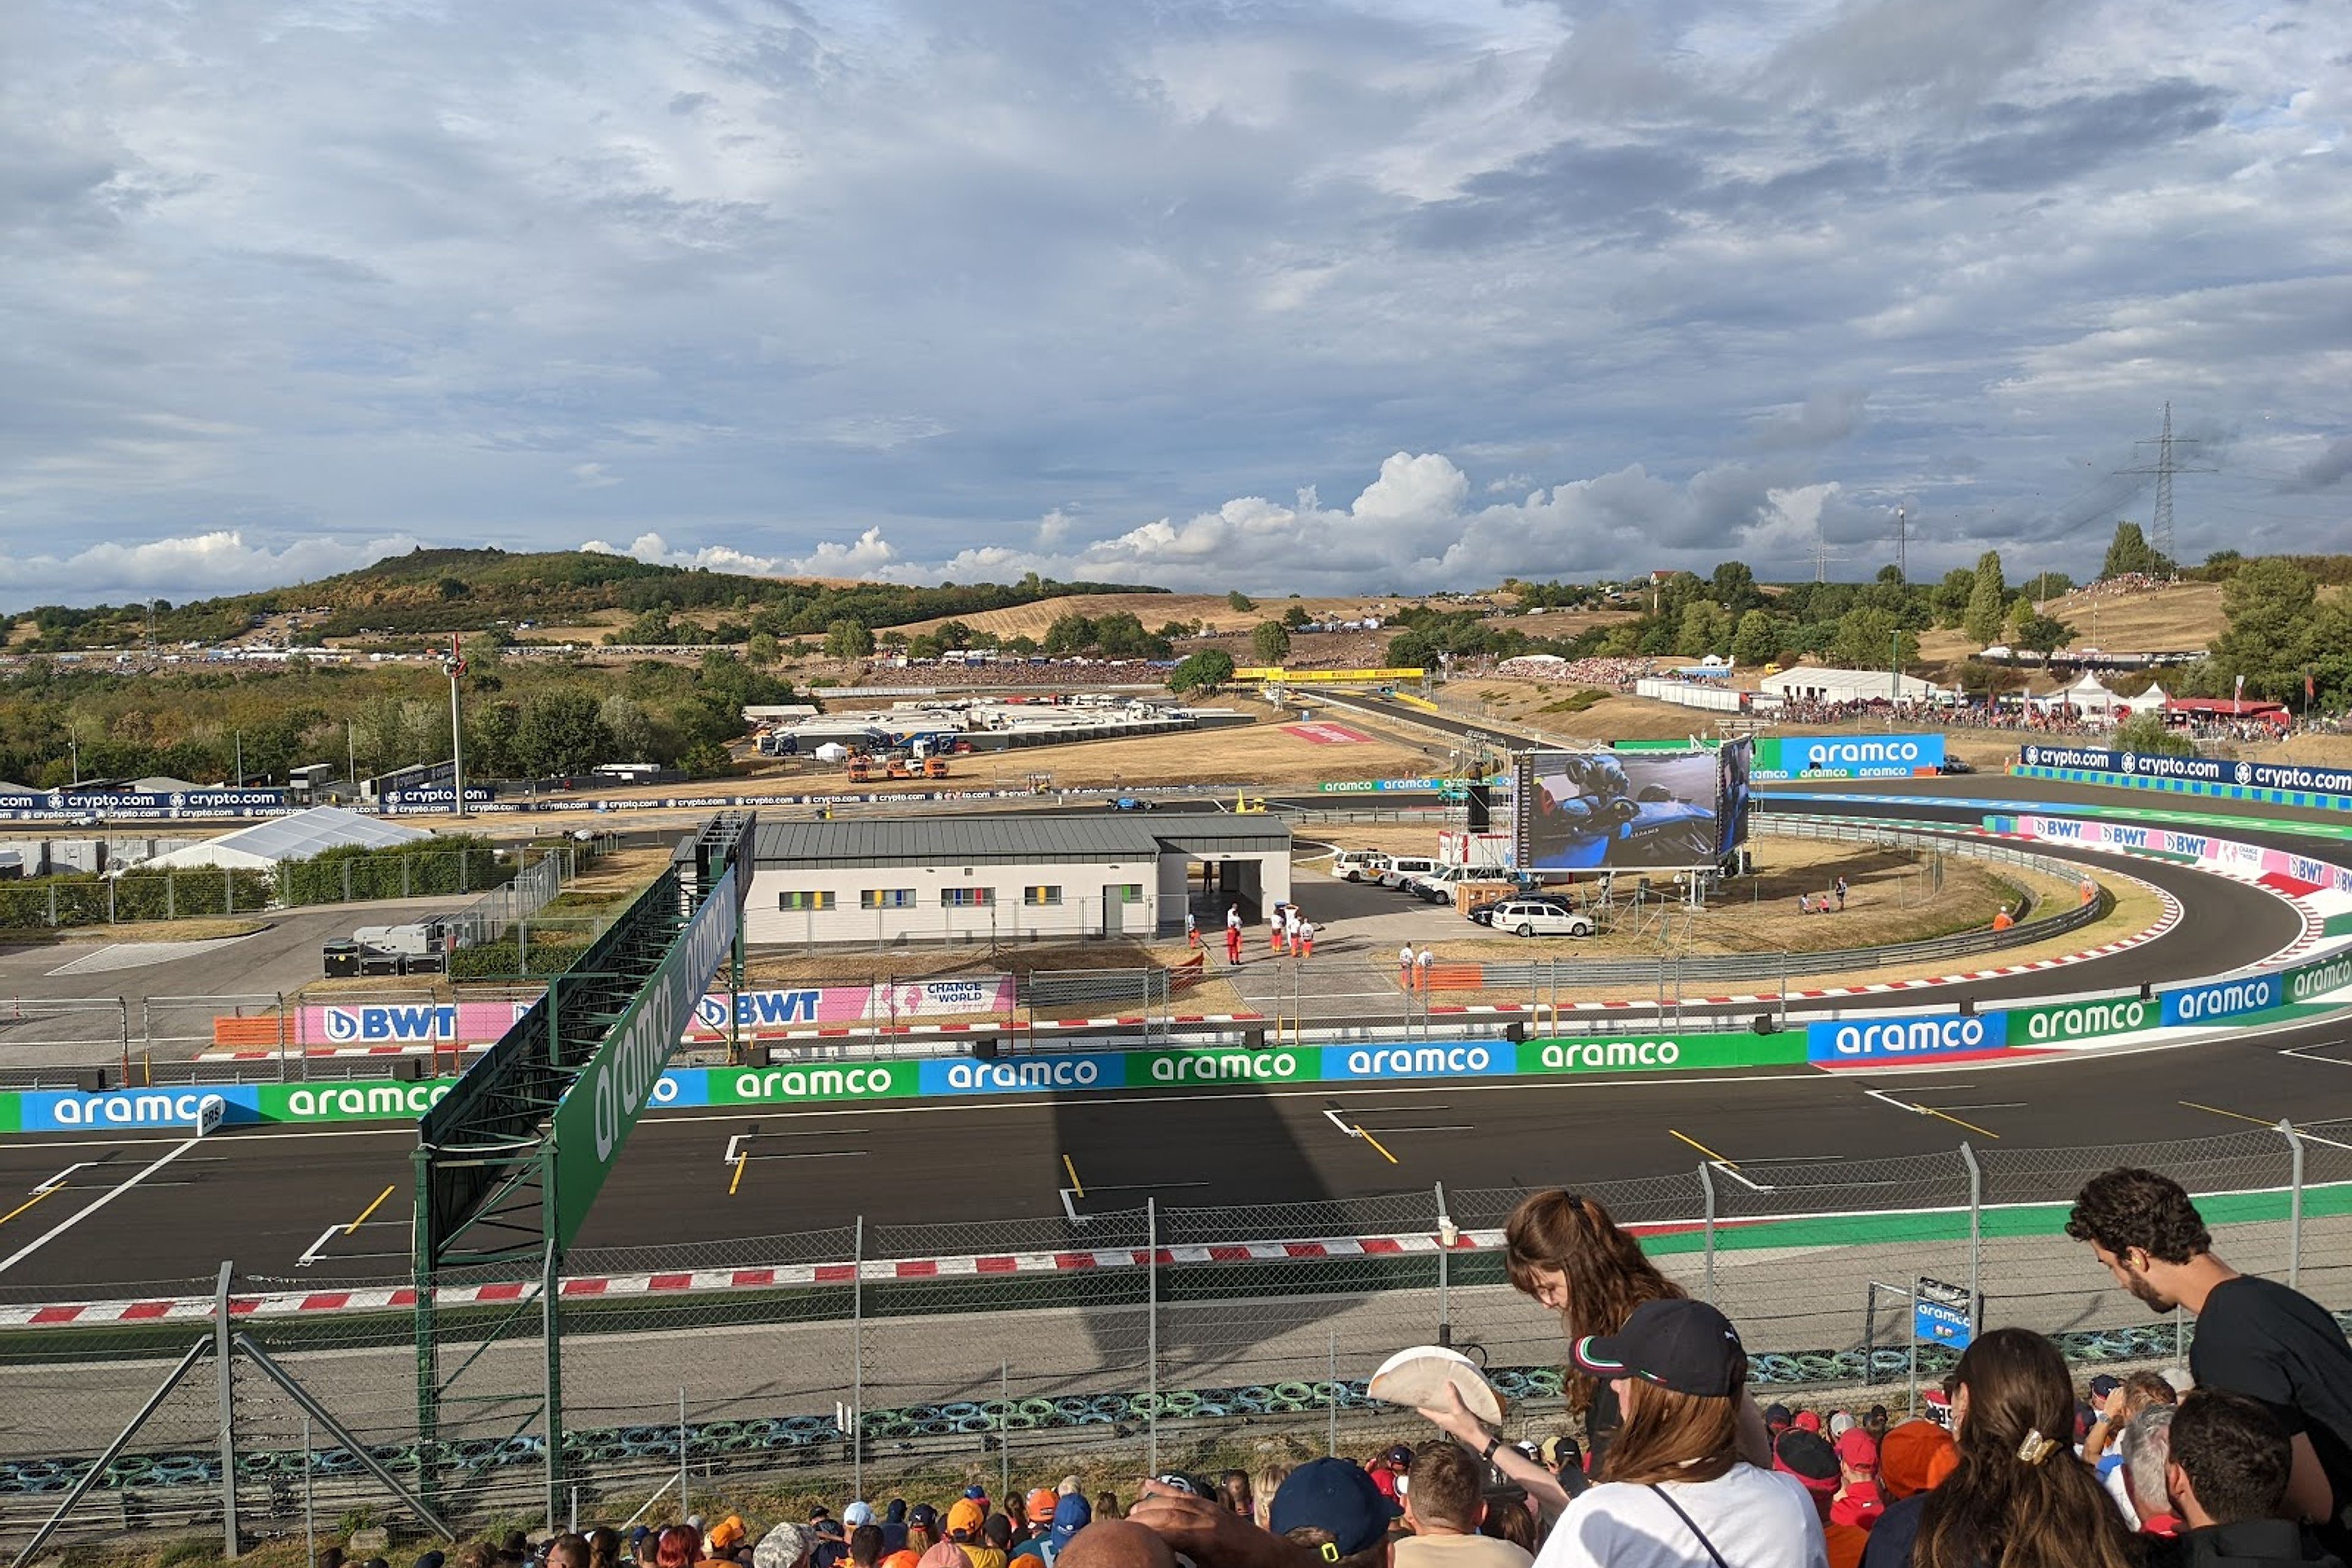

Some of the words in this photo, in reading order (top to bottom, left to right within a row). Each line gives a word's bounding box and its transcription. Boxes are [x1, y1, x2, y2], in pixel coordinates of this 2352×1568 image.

[1809, 743, 1918, 762] aramco
[2041, 750, 2109, 767] crypto.com
[1749, 769, 1788, 779] ramco
[1800, 767, 1847, 777] aramco
[1860, 767, 1907, 777] aramco
[2139, 758, 2219, 777] crypto.com
[1325, 782, 1372, 791] aramco
[1384, 779, 1431, 789] aramco
[2255, 767, 2351, 791] crypto.com
[68, 794, 154, 808] crypto.com
[190, 793, 275, 806] crypto.com
[404, 789, 488, 802] crypto.om
[609, 799, 658, 808] crypto.com
[678, 797, 726, 806] crypto.com
[745, 796, 793, 805] crypto.com
[879, 793, 925, 802] crypto.com
[182, 808, 234, 817] crypto.com
[399, 805, 449, 813] crypto.com
[540, 801, 589, 810] crypto.com
[34, 810, 86, 819] crypto.com
[2048, 821, 2081, 838] BWT
[2114, 828, 2147, 846] BWT
[2177, 835, 2206, 856] BWT
[2299, 859, 2323, 883] BWT
[686, 889, 726, 1005] aramco
[2294, 960, 2350, 997] aramco
[928, 982, 981, 993] CHANGE
[940, 992, 982, 1002] WORLD
[2179, 982, 2269, 1019] aramco
[736, 992, 819, 1024] BWT
[363, 1008, 455, 1038] BWT
[2029, 1001, 2143, 1038] aramco
[1837, 1019, 1983, 1054] aramco
[1349, 1047, 1489, 1073] aramco
[1542, 1041, 1679, 1067] aramco
[595, 974, 673, 1163] aramco
[949, 1060, 1098, 1088] aramco
[1152, 1053, 1296, 1080] aramco
[736, 1069, 891, 1097] aramco
[203, 1106, 219, 1127] DRS
